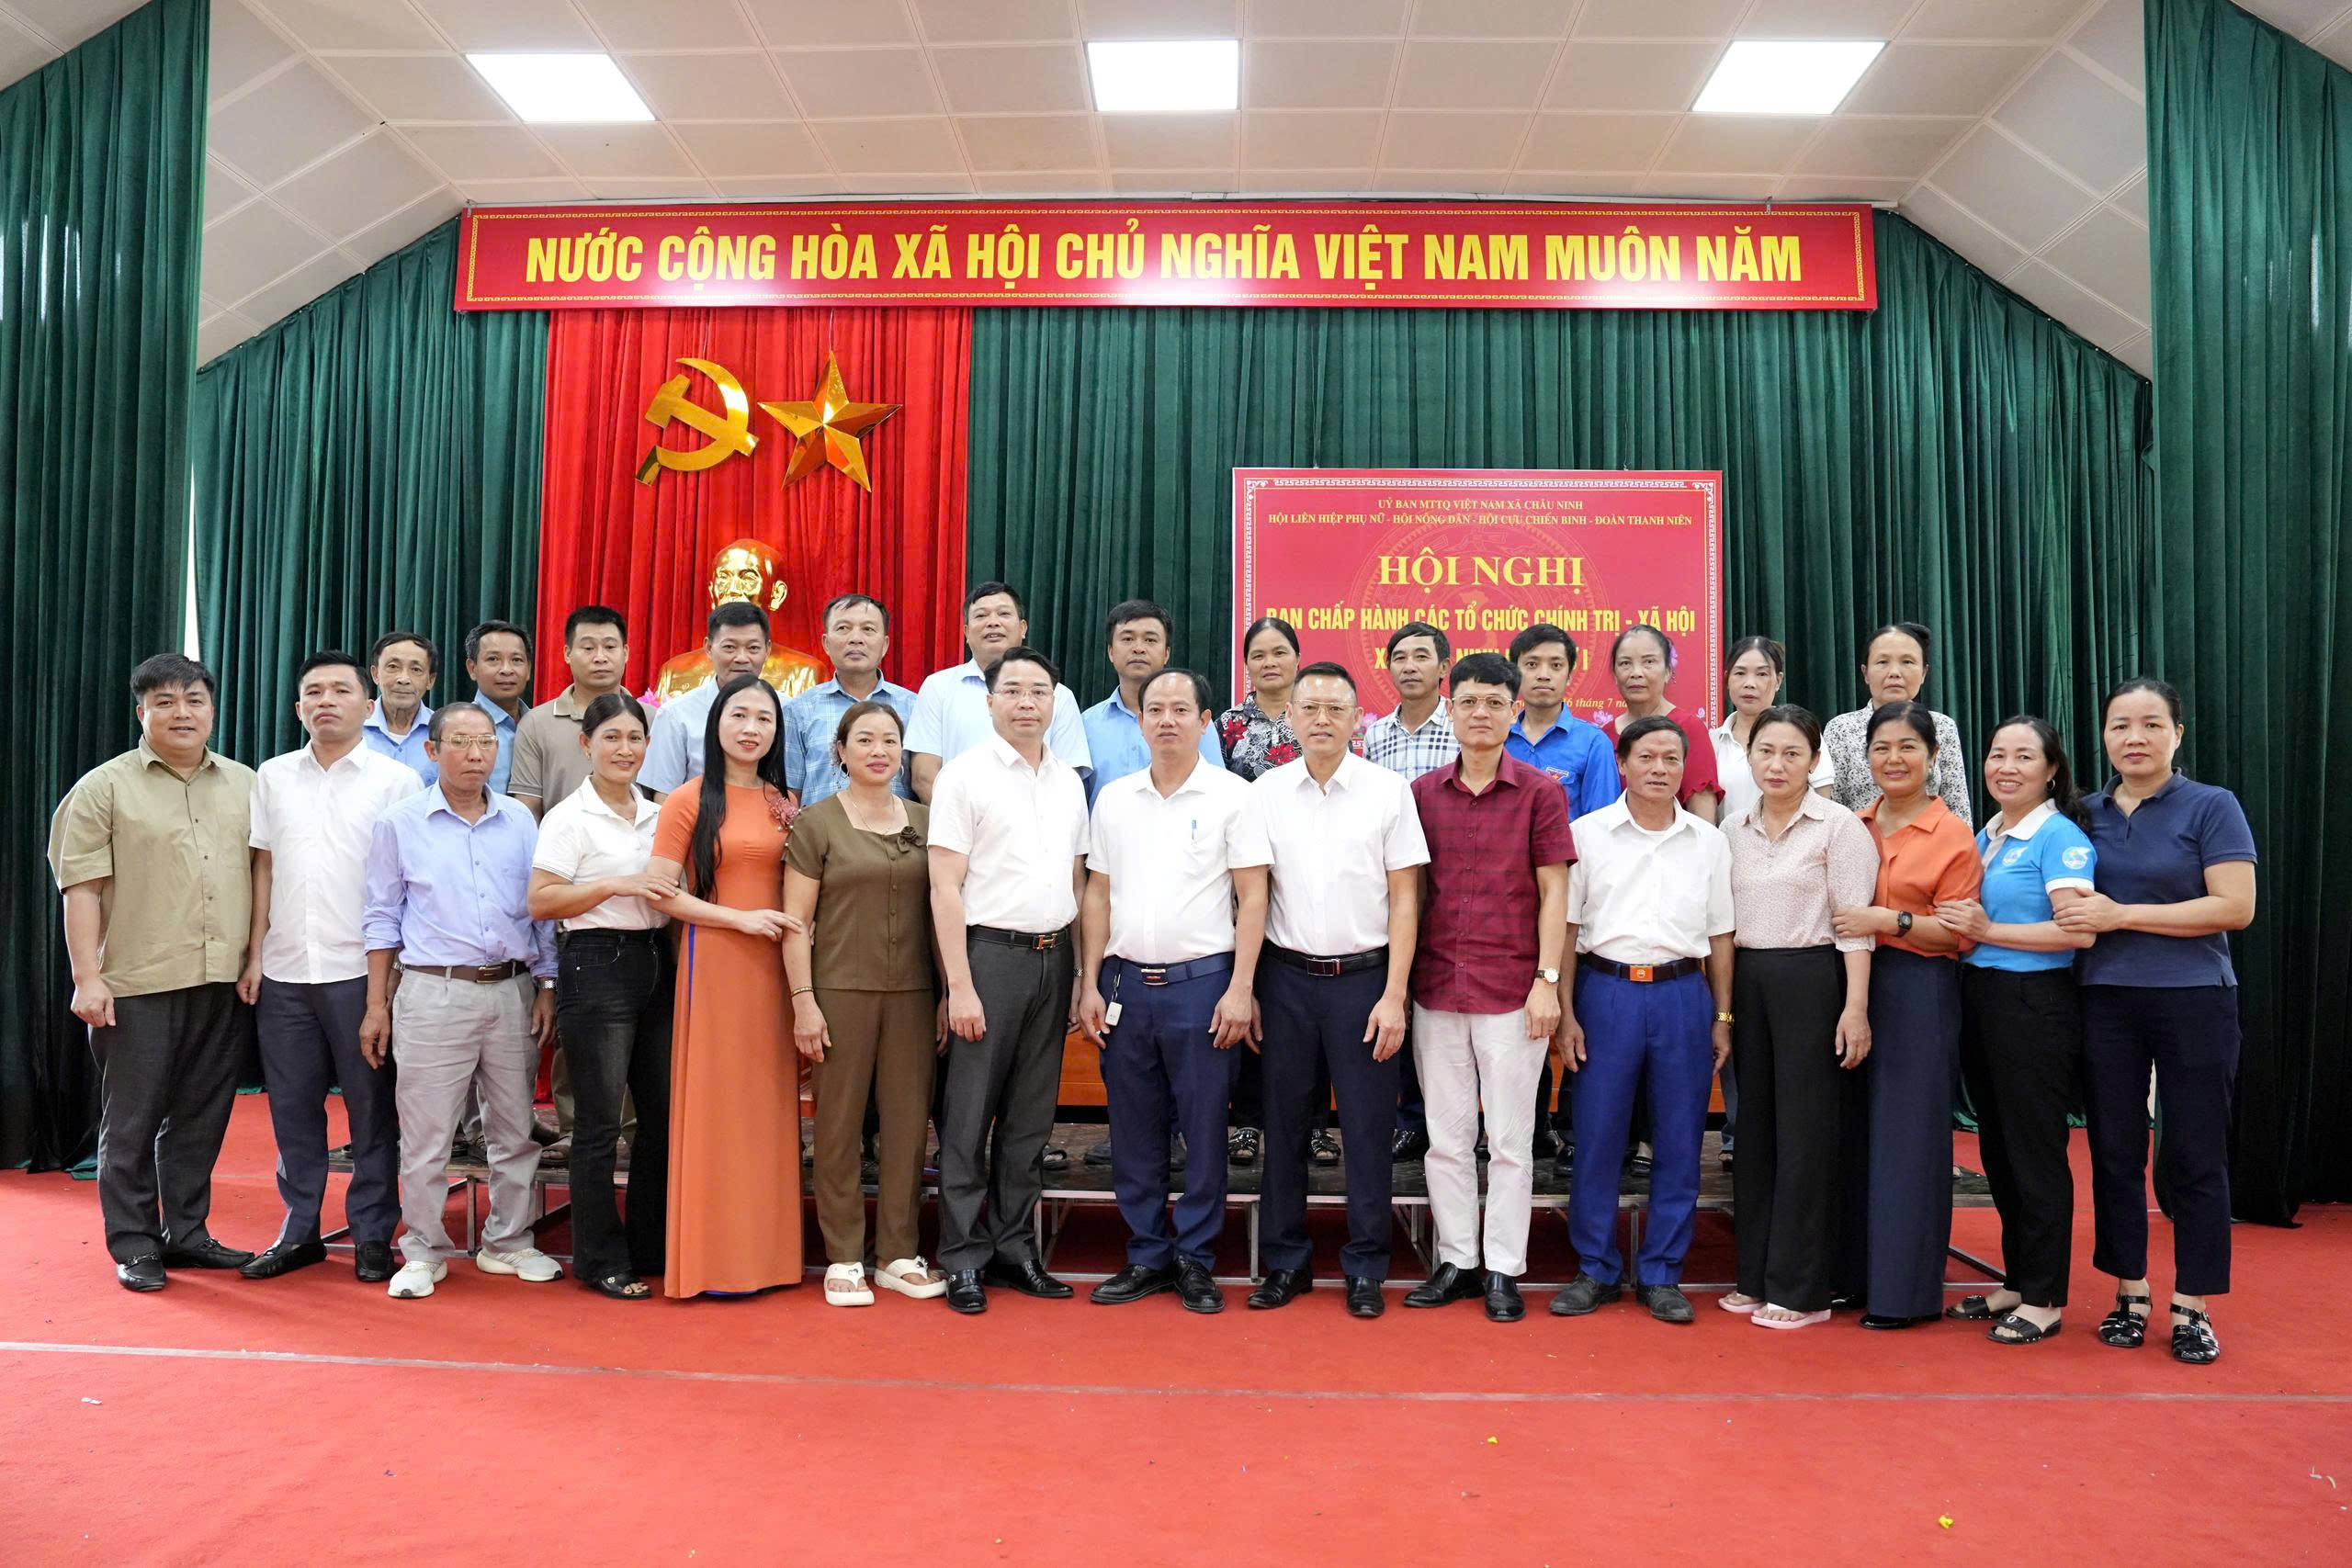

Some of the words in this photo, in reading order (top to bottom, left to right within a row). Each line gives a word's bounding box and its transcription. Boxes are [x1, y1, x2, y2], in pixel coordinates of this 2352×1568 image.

[525, 227, 643, 283] NƯỚC
[657, 225, 775, 290] CỘNG
[790, 223, 878, 279] HÒA
[891, 225, 952, 279] XÃ
[966, 224, 1040, 289] HỘI
[1055, 218, 1145, 280] CHỦ
[1160, 225, 1300, 279] NGHĨA
[1314, 225, 1410, 290] VIỆT
[1424, 234, 1529, 280] NAM
[1545, 225, 1680, 281] MUÔN
[1695, 225, 1801, 282] NĂM
[1396, 500, 1417, 509] BAN
[1419, 500, 1451, 511] MTTQ
[1453, 498, 1477, 512] VIỆT
[1480, 501, 1505, 510] NAM
[1508, 499, 1521, 510] XÃ
[1524, 498, 1555, 510] CHÂU
[1556, 501, 1583, 510] NINH
[1269, 512, 1288, 525] HỘI
[1291, 512, 1316, 524] LIÊN
[1318, 512, 1343, 525] HIỆP
[1345, 514, 1367, 525] PHỤ
[1370, 512, 1385, 524] NỮ
[1393, 513, 1412, 525] HỘI
[1415, 513, 1445, 525] NÔNG
[1448, 513, 1470, 525] DÂN
[1478, 513, 1498, 526] HỘI
[1525, 512, 1558, 525] CHIẾN
[1561, 515, 1587, 525] BINH
[1595, 513, 1625, 525] ĐOÀN
[1627, 515, 1665, 525] THANH
[1667, 514, 1692, 525] NIÊN
[1378, 547, 1459, 593] HỘI
[1471, 556, 1584, 594] NGHỊ
[1308, 601, 1355, 630] CHẤP
[1361, 604, 1408, 630] HÀNH
[1415, 604, 1450, 631] CÁC
[1455, 601, 1476, 631] TỔ
[1482, 604, 1528, 631] CHỨC
[1534, 605, 1588, 632] CHÍNH
[1593, 610, 1620, 637] TRỊ
[1638, 606, 1660, 632] XÃ
[1667, 605, 1695, 637] HỘI
[1576, 698, 1604, 710] tháng
[1607, 698, 1613, 707] 7
